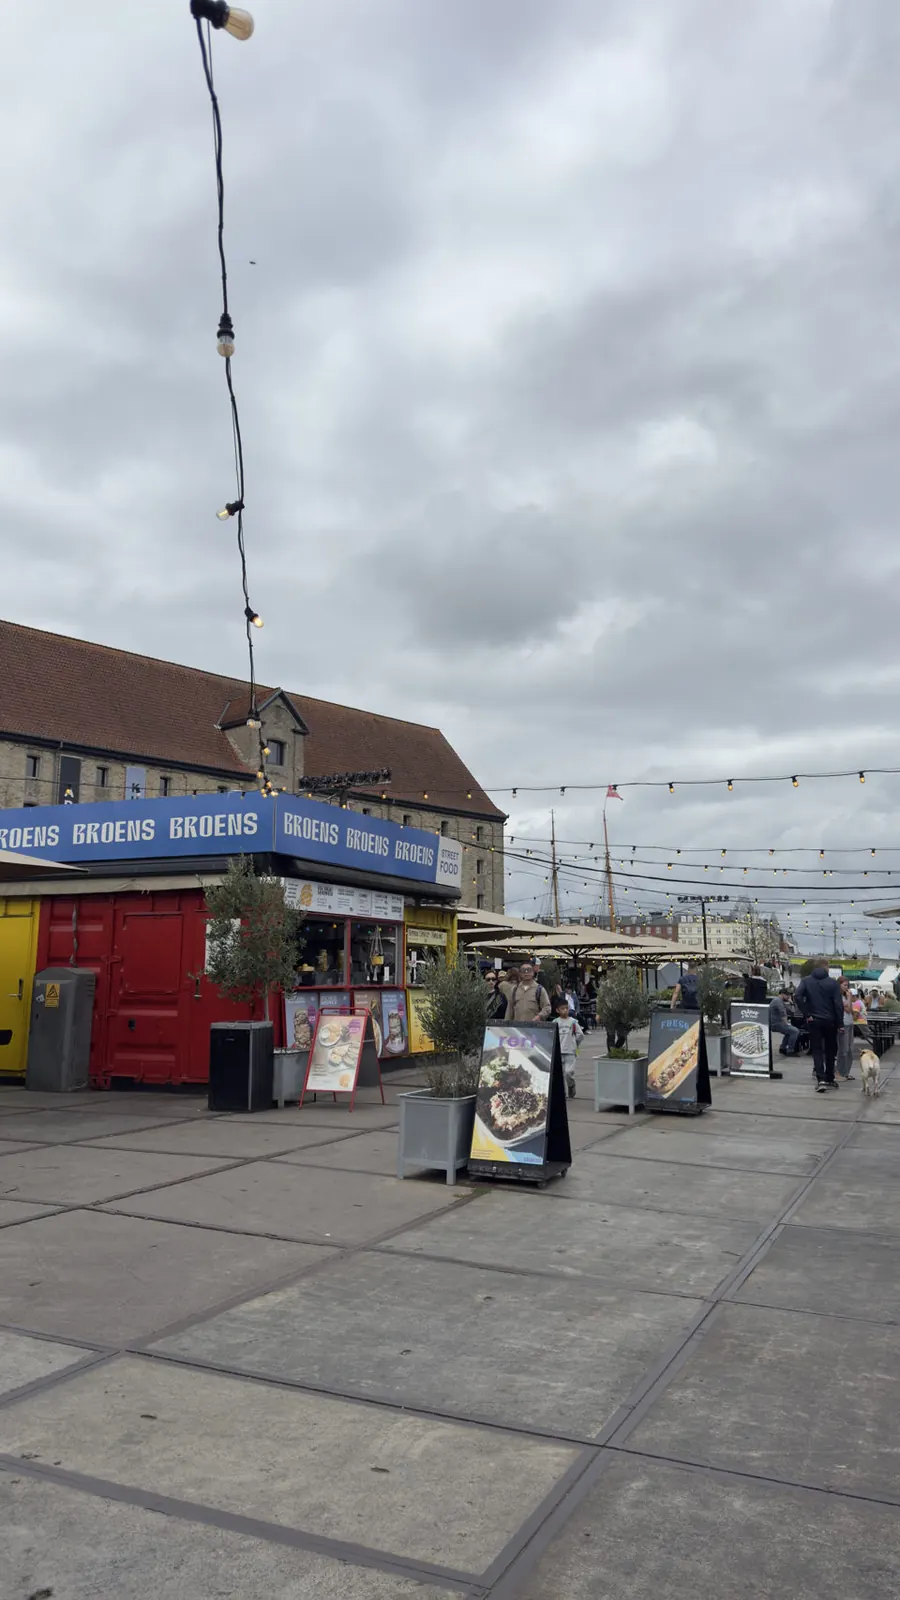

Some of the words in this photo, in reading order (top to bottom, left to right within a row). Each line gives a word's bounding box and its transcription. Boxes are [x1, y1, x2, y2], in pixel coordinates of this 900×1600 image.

[72, 818, 156, 845] BROENS
[169, 812, 258, 839] BROENS
[284, 812, 339, 845] BROENS
[346, 827, 389, 856] BROENS
[394, 840, 434, 866] BROENS
[440, 848, 459, 861] STREET
[439, 860, 458, 875] FOOD
[660, 1019, 690, 1030] FUEGO
